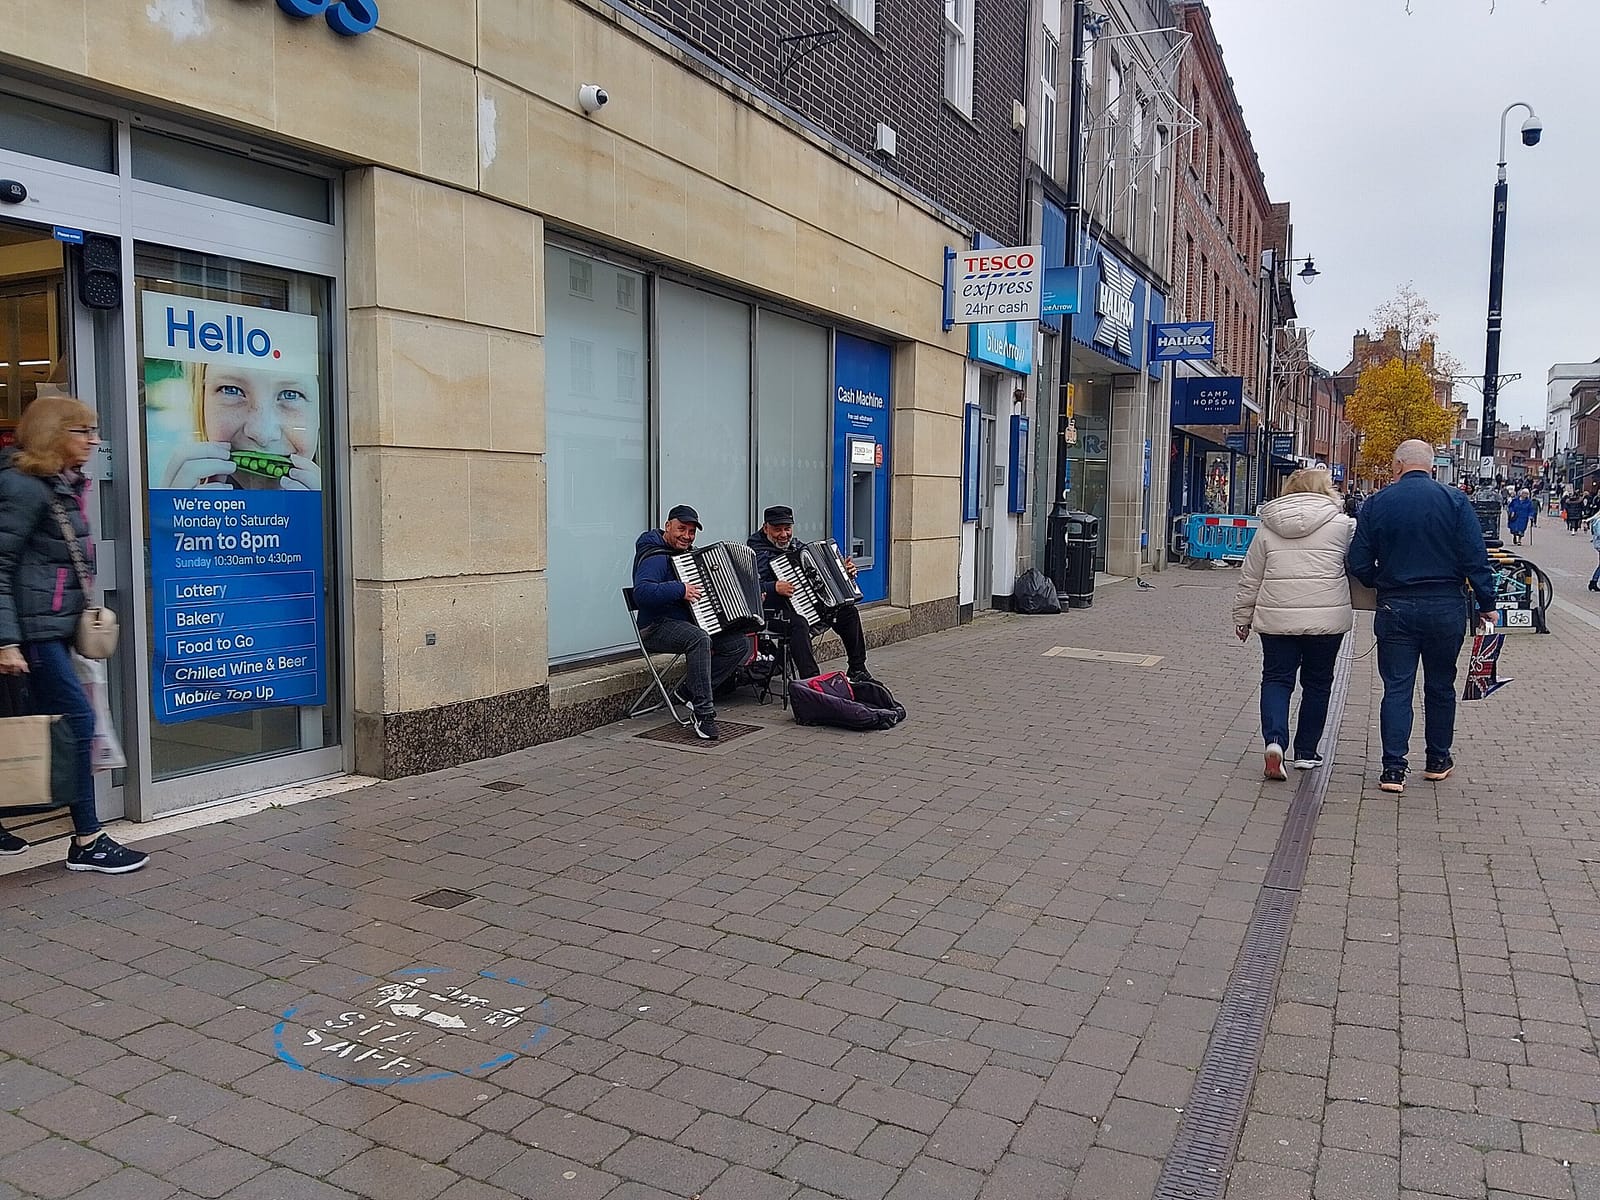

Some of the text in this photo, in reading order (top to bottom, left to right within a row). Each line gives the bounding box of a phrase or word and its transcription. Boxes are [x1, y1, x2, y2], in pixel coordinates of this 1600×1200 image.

[964, 253, 1034, 272] TESCO
[963, 280, 1033, 300] express
[965, 300, 1029, 316] 24hr cash
[1100, 281, 1134, 329] HALIFAX
[166, 306, 281, 359] Hello.
[1158, 335, 1211, 347] HALIFAX
[986, 328, 1025, 362] blueArrow
[837, 386, 883, 409] Cash Machine
[1200, 390, 1228, 398] CAMP
[173, 497, 246, 513] We're open
[173, 513, 290, 530] Monday to Saturday
[174, 531, 280, 552] 7am to 8pm
[175, 552, 302, 569] Sunday 10:30am to 4:30pm
[175, 584, 227, 599] Lottery
[176, 611, 224, 627] Bakery
[177, 634, 254, 654] Food to Go
[175, 656, 308, 680] Chilled Wine & Beer
[174, 685, 274, 707] Mobile Top Up
